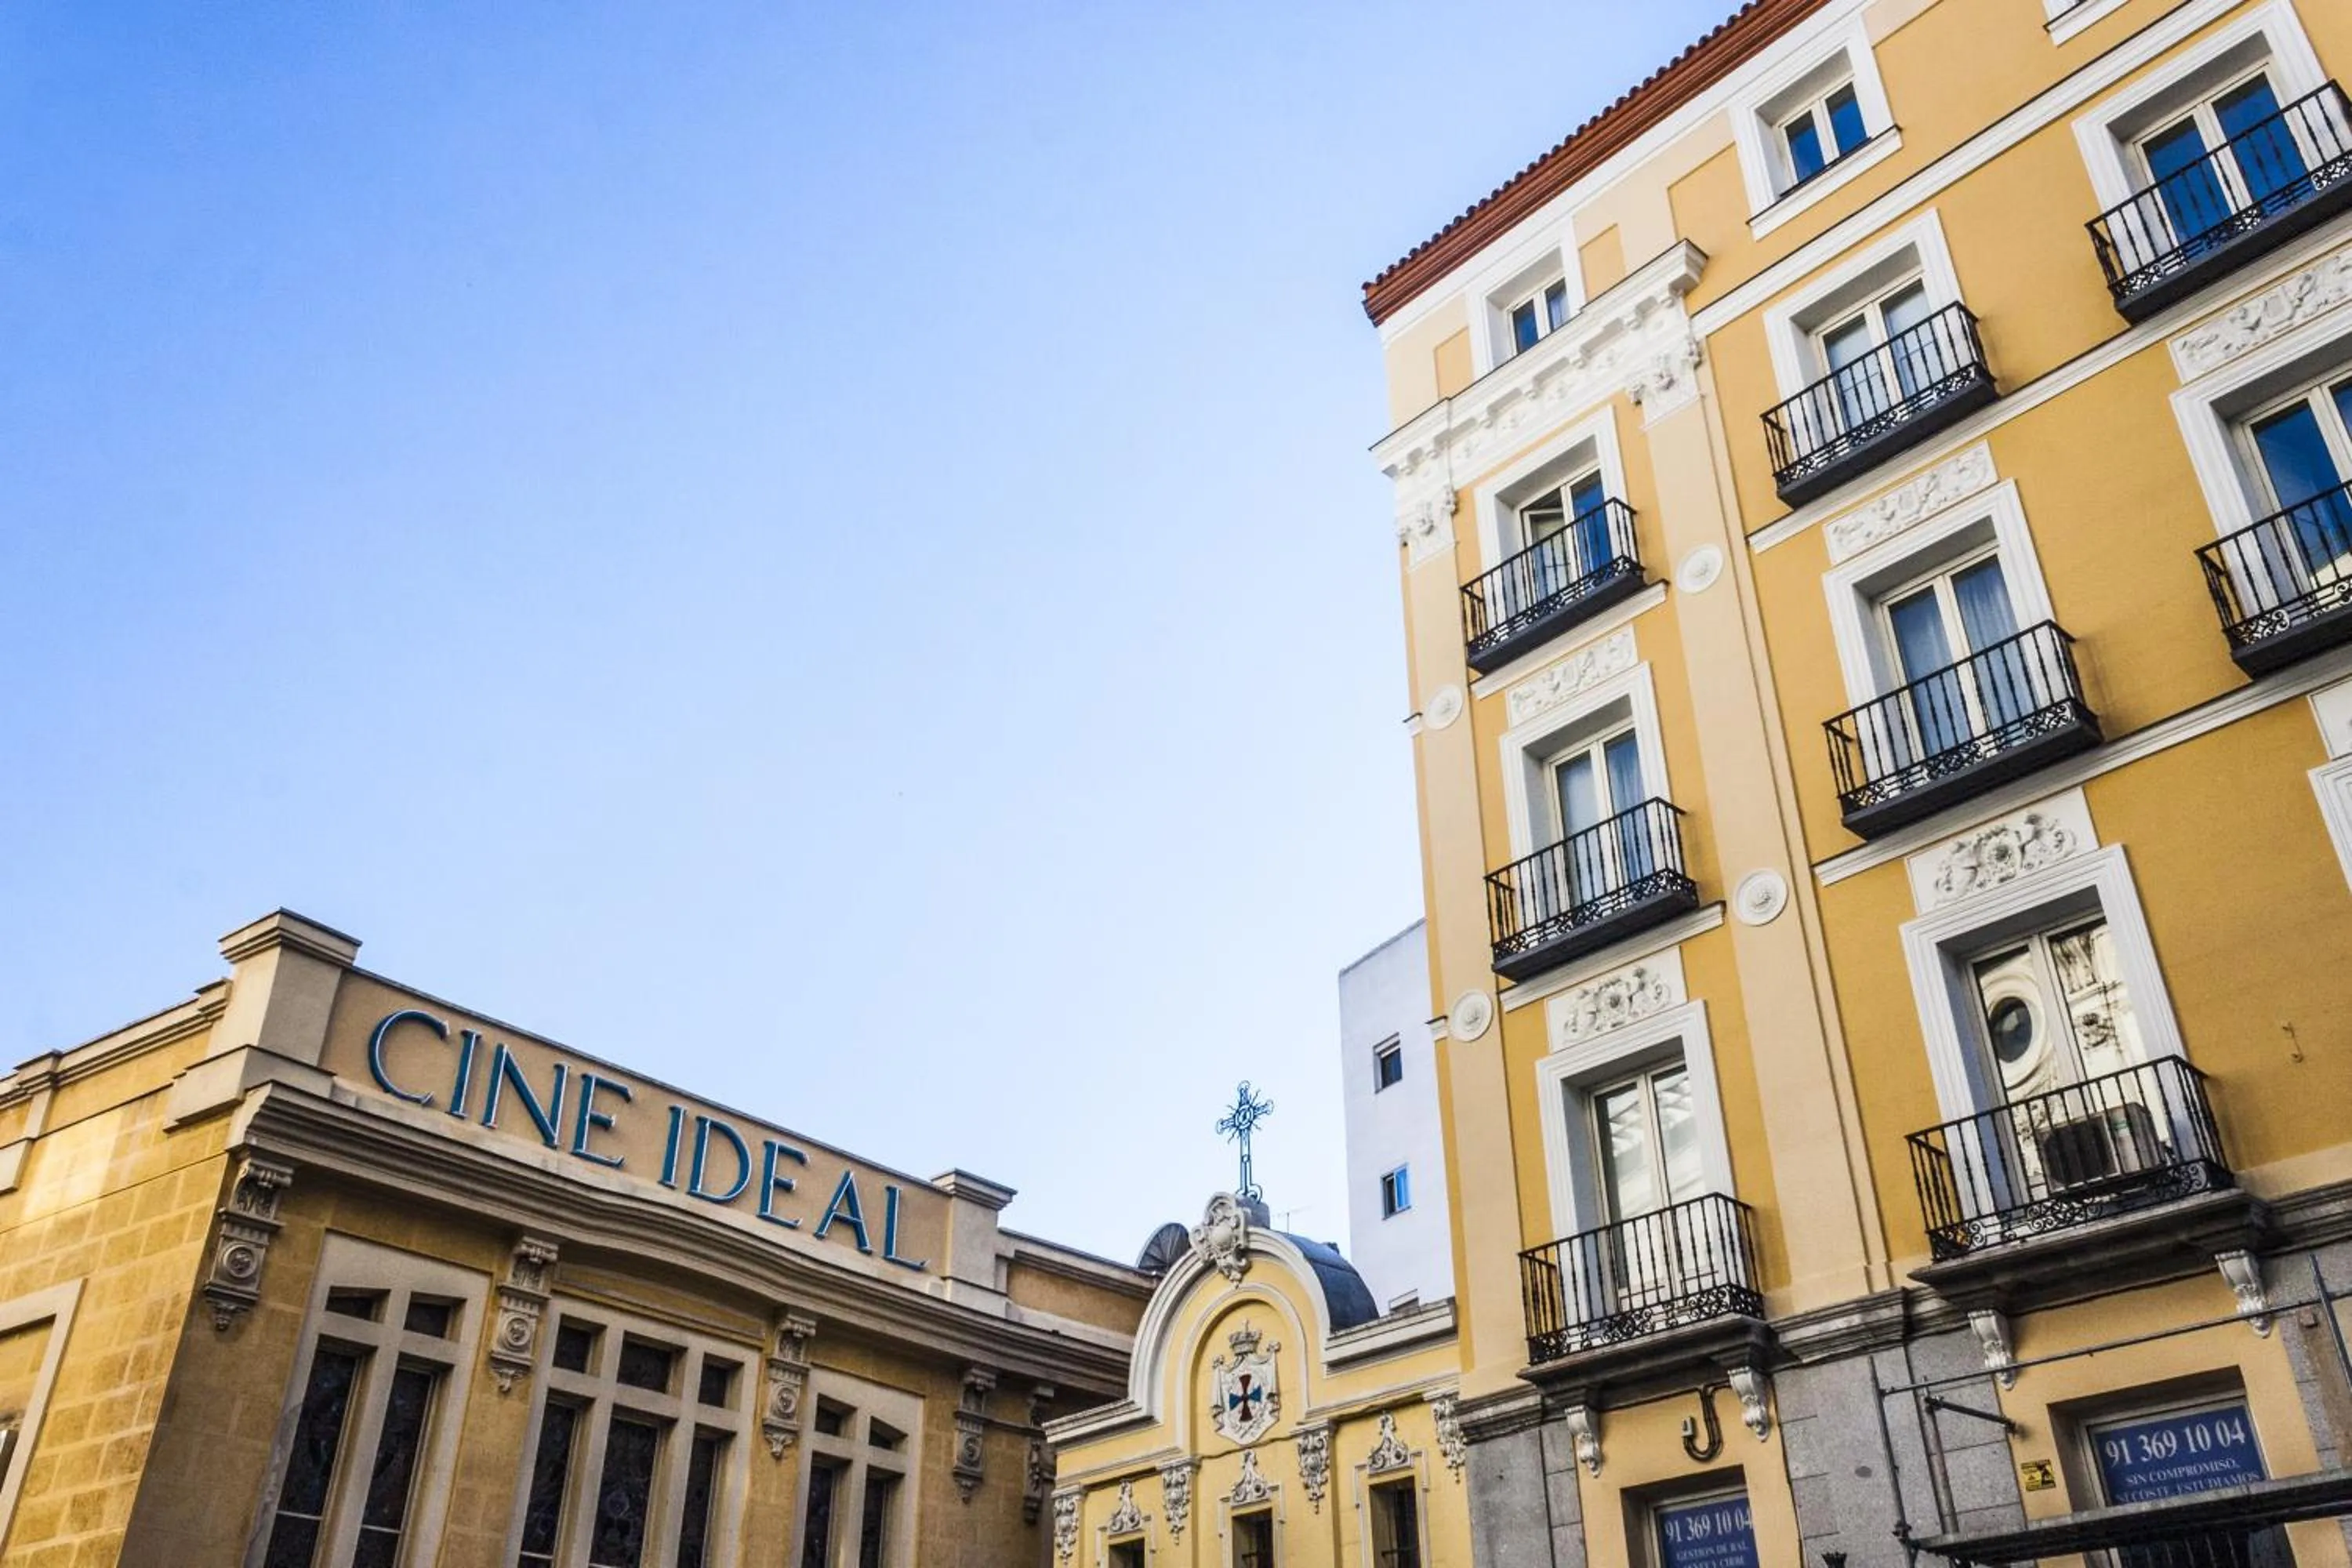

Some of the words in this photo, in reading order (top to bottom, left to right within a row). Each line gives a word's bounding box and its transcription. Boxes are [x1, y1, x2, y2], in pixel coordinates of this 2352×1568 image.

[368, 1010, 634, 1168] CINE
[658, 1105, 931, 1272] IDEAL
[2104, 1438, 2133, 1468] 91
[2138, 1429, 2178, 1462] 369
[2184, 1423, 2212, 1454] 10
[2215, 1417, 2245, 1448] 04
[2125, 1473, 2147, 1486] SIN
[1664, 1519, 1683, 1543] 91
[1686, 1514, 1711, 1541] 369
[1715, 1508, 1733, 1536] 10
[1735, 1507, 1753, 1530] 04
